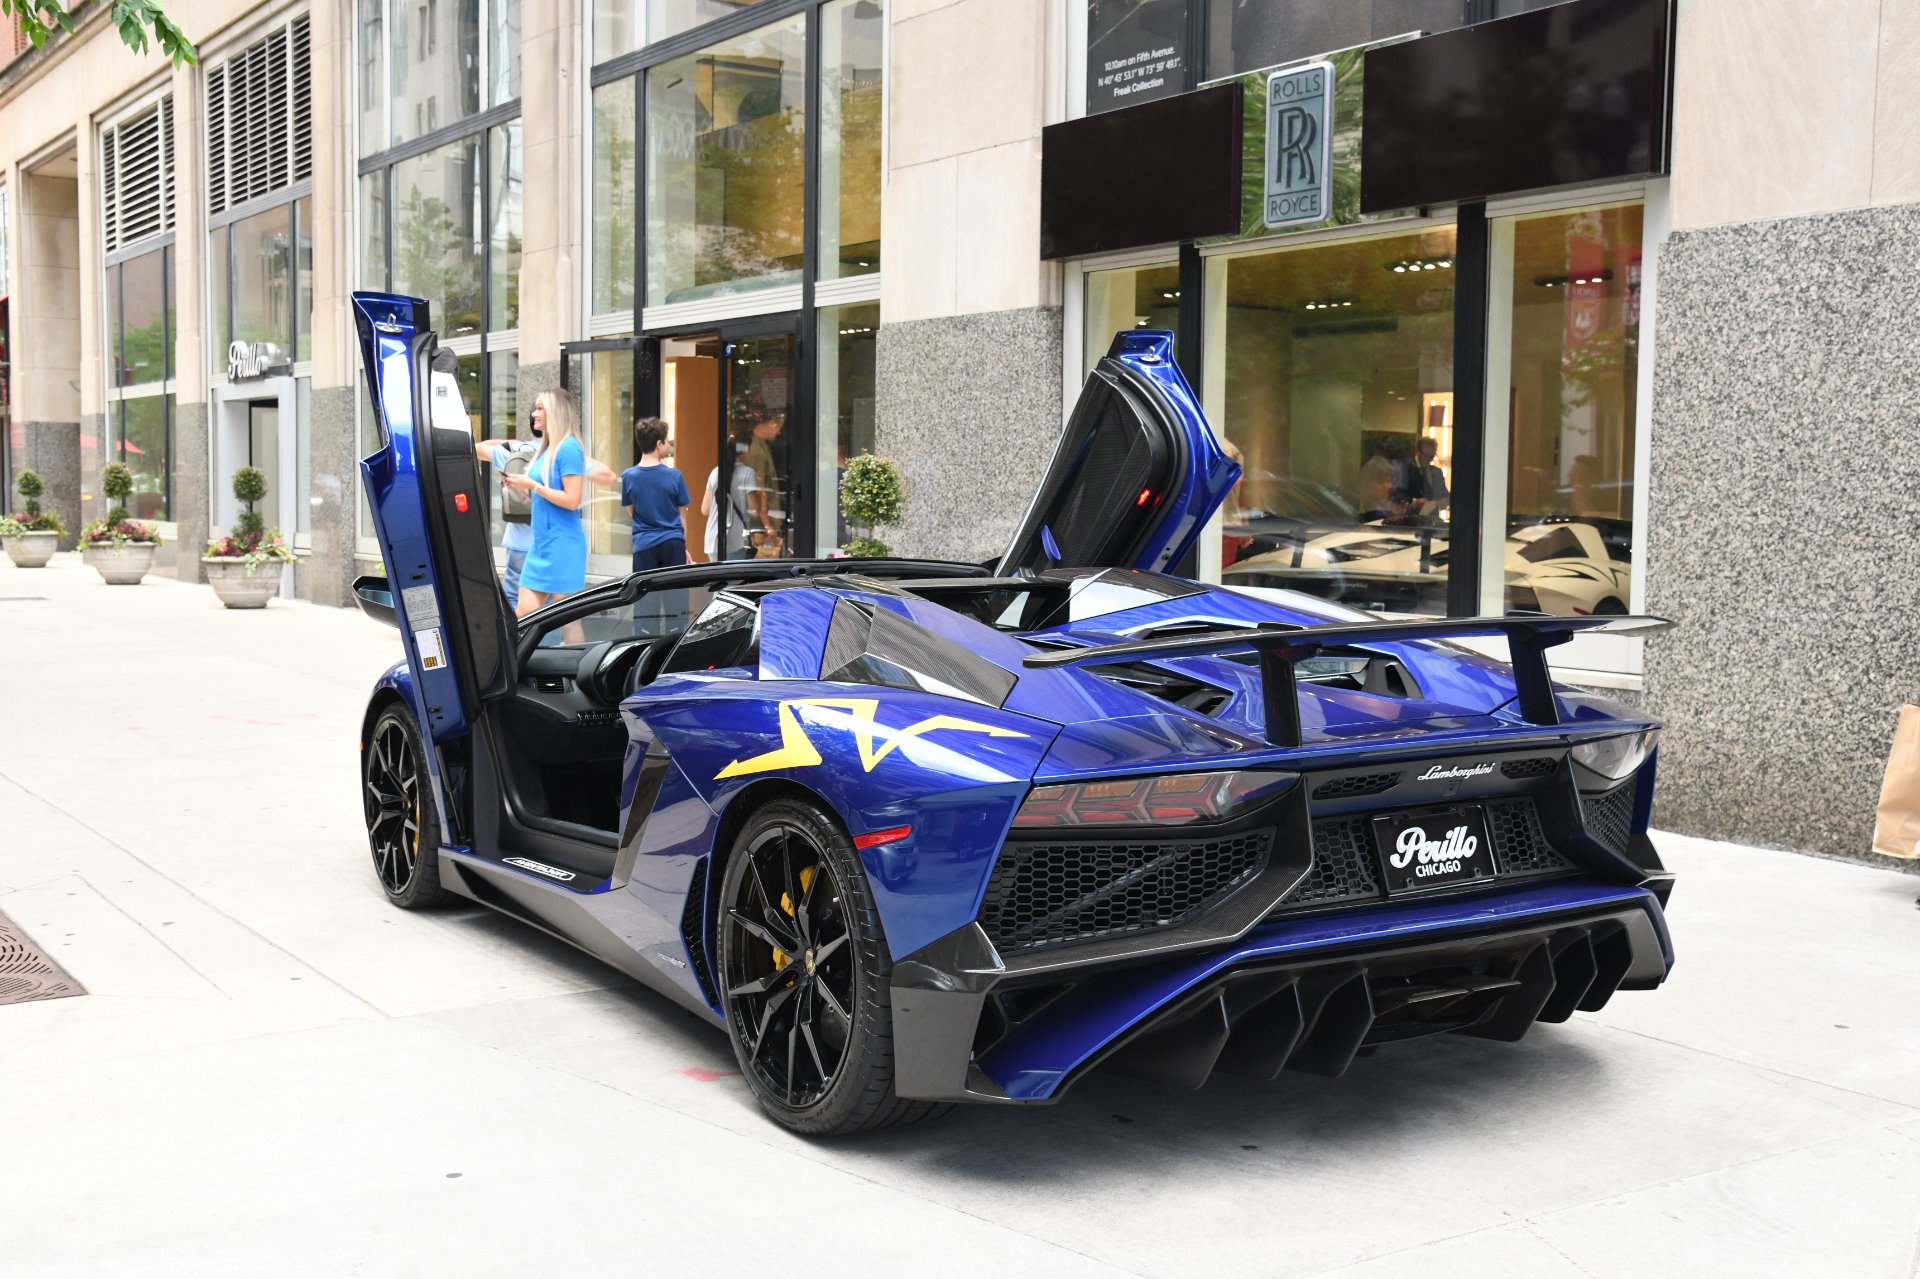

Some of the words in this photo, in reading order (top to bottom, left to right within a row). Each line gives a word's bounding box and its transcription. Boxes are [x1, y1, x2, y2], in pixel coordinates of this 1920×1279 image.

[1127, 57, 1136, 66] on
[1136, 51, 1151, 63] Fifth
[1098, 78, 1104, 87] N
[1138, 66, 1145, 77] W
[1113, 85, 1132, 97] Freak
[1131, 78, 1164, 92] Collection
[1273, 74, 1320, 100] ROLLS
[1270, 194, 1318, 217] ROYCE
[1417, 763, 1495, 780] Lamborghini
[1389, 826, 1478, 869] Perillo
[1415, 859, 1461, 878] CHICAGO
